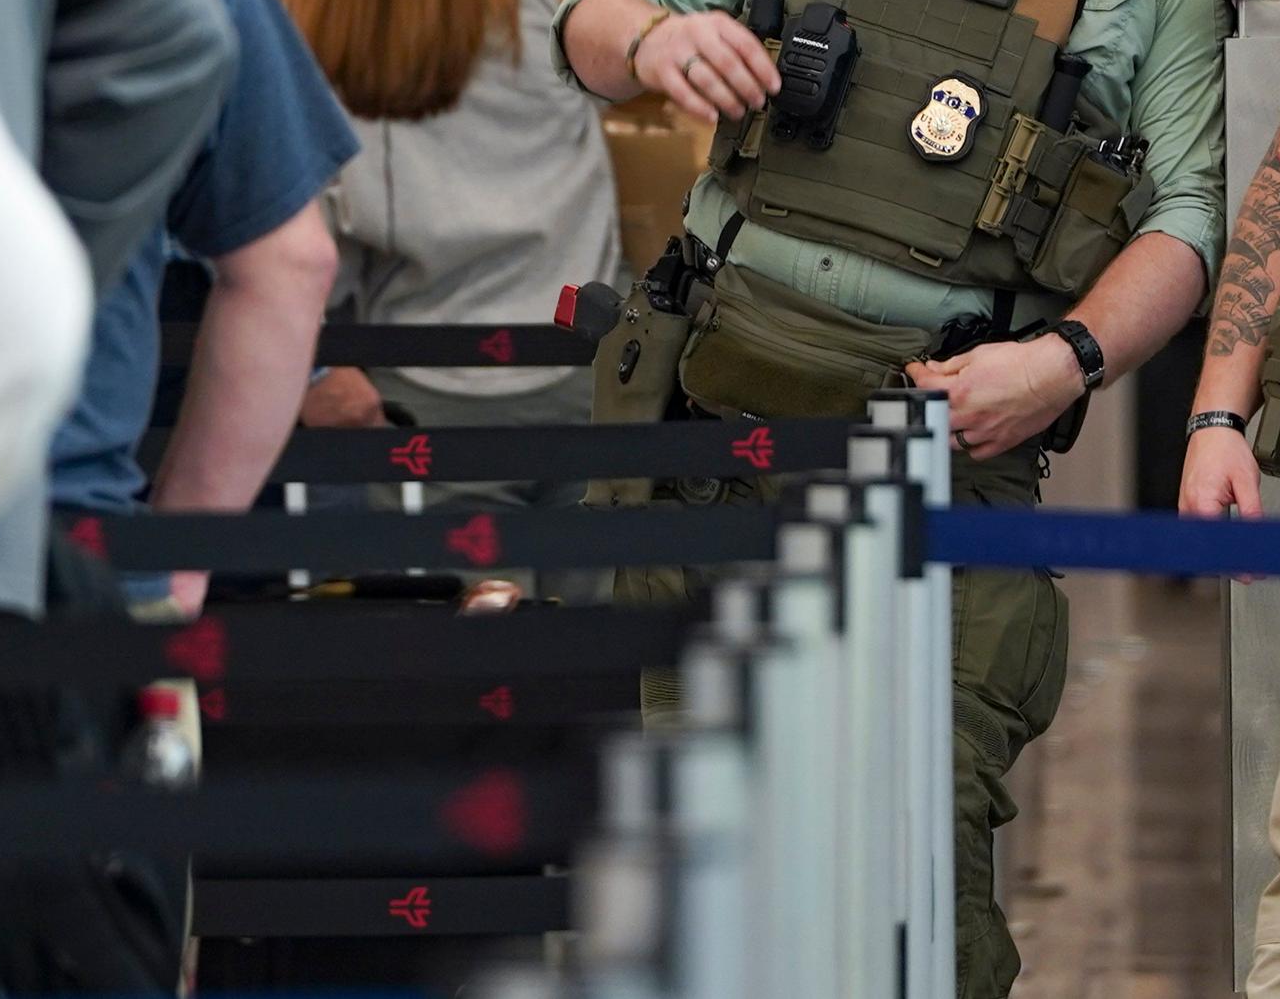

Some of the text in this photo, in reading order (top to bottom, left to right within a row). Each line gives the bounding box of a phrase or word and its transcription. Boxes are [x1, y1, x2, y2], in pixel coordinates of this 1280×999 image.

[792, 36, 829, 49] MOTOROLA
[920, 113, 964, 142] U S
